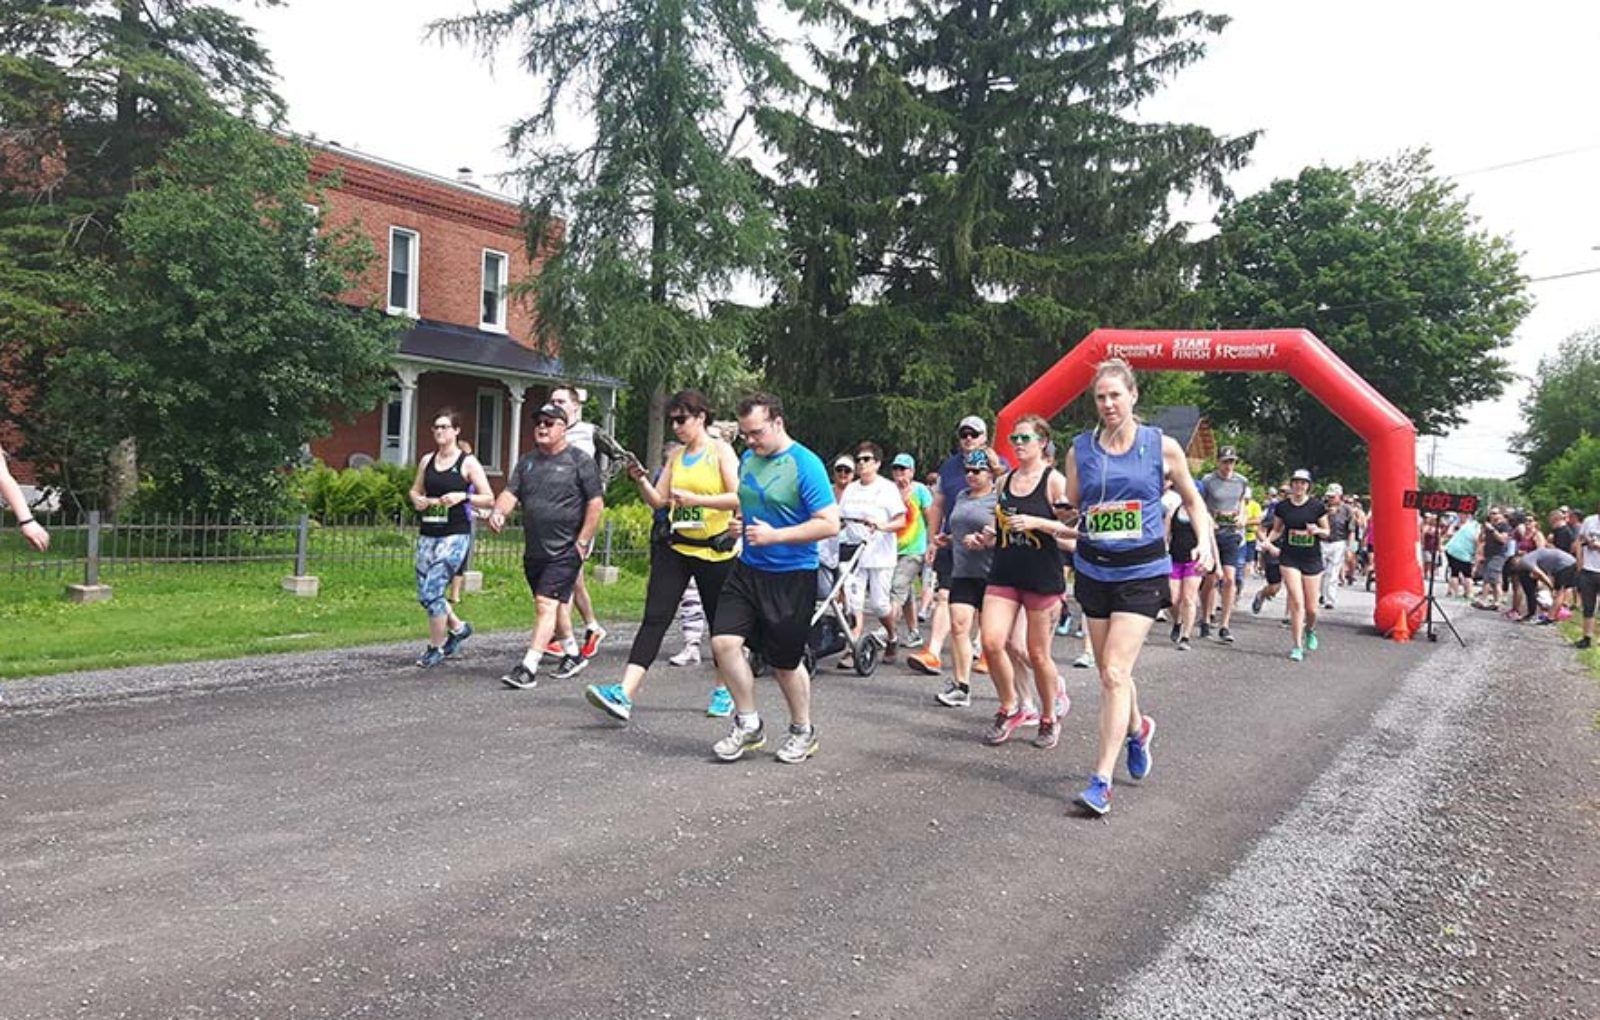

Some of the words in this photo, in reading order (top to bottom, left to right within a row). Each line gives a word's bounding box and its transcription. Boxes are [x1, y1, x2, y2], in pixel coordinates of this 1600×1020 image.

[1173, 338, 1212, 349] START
[1172, 349, 1211, 360] FINISH
[1092, 512, 1136, 532] 1258
